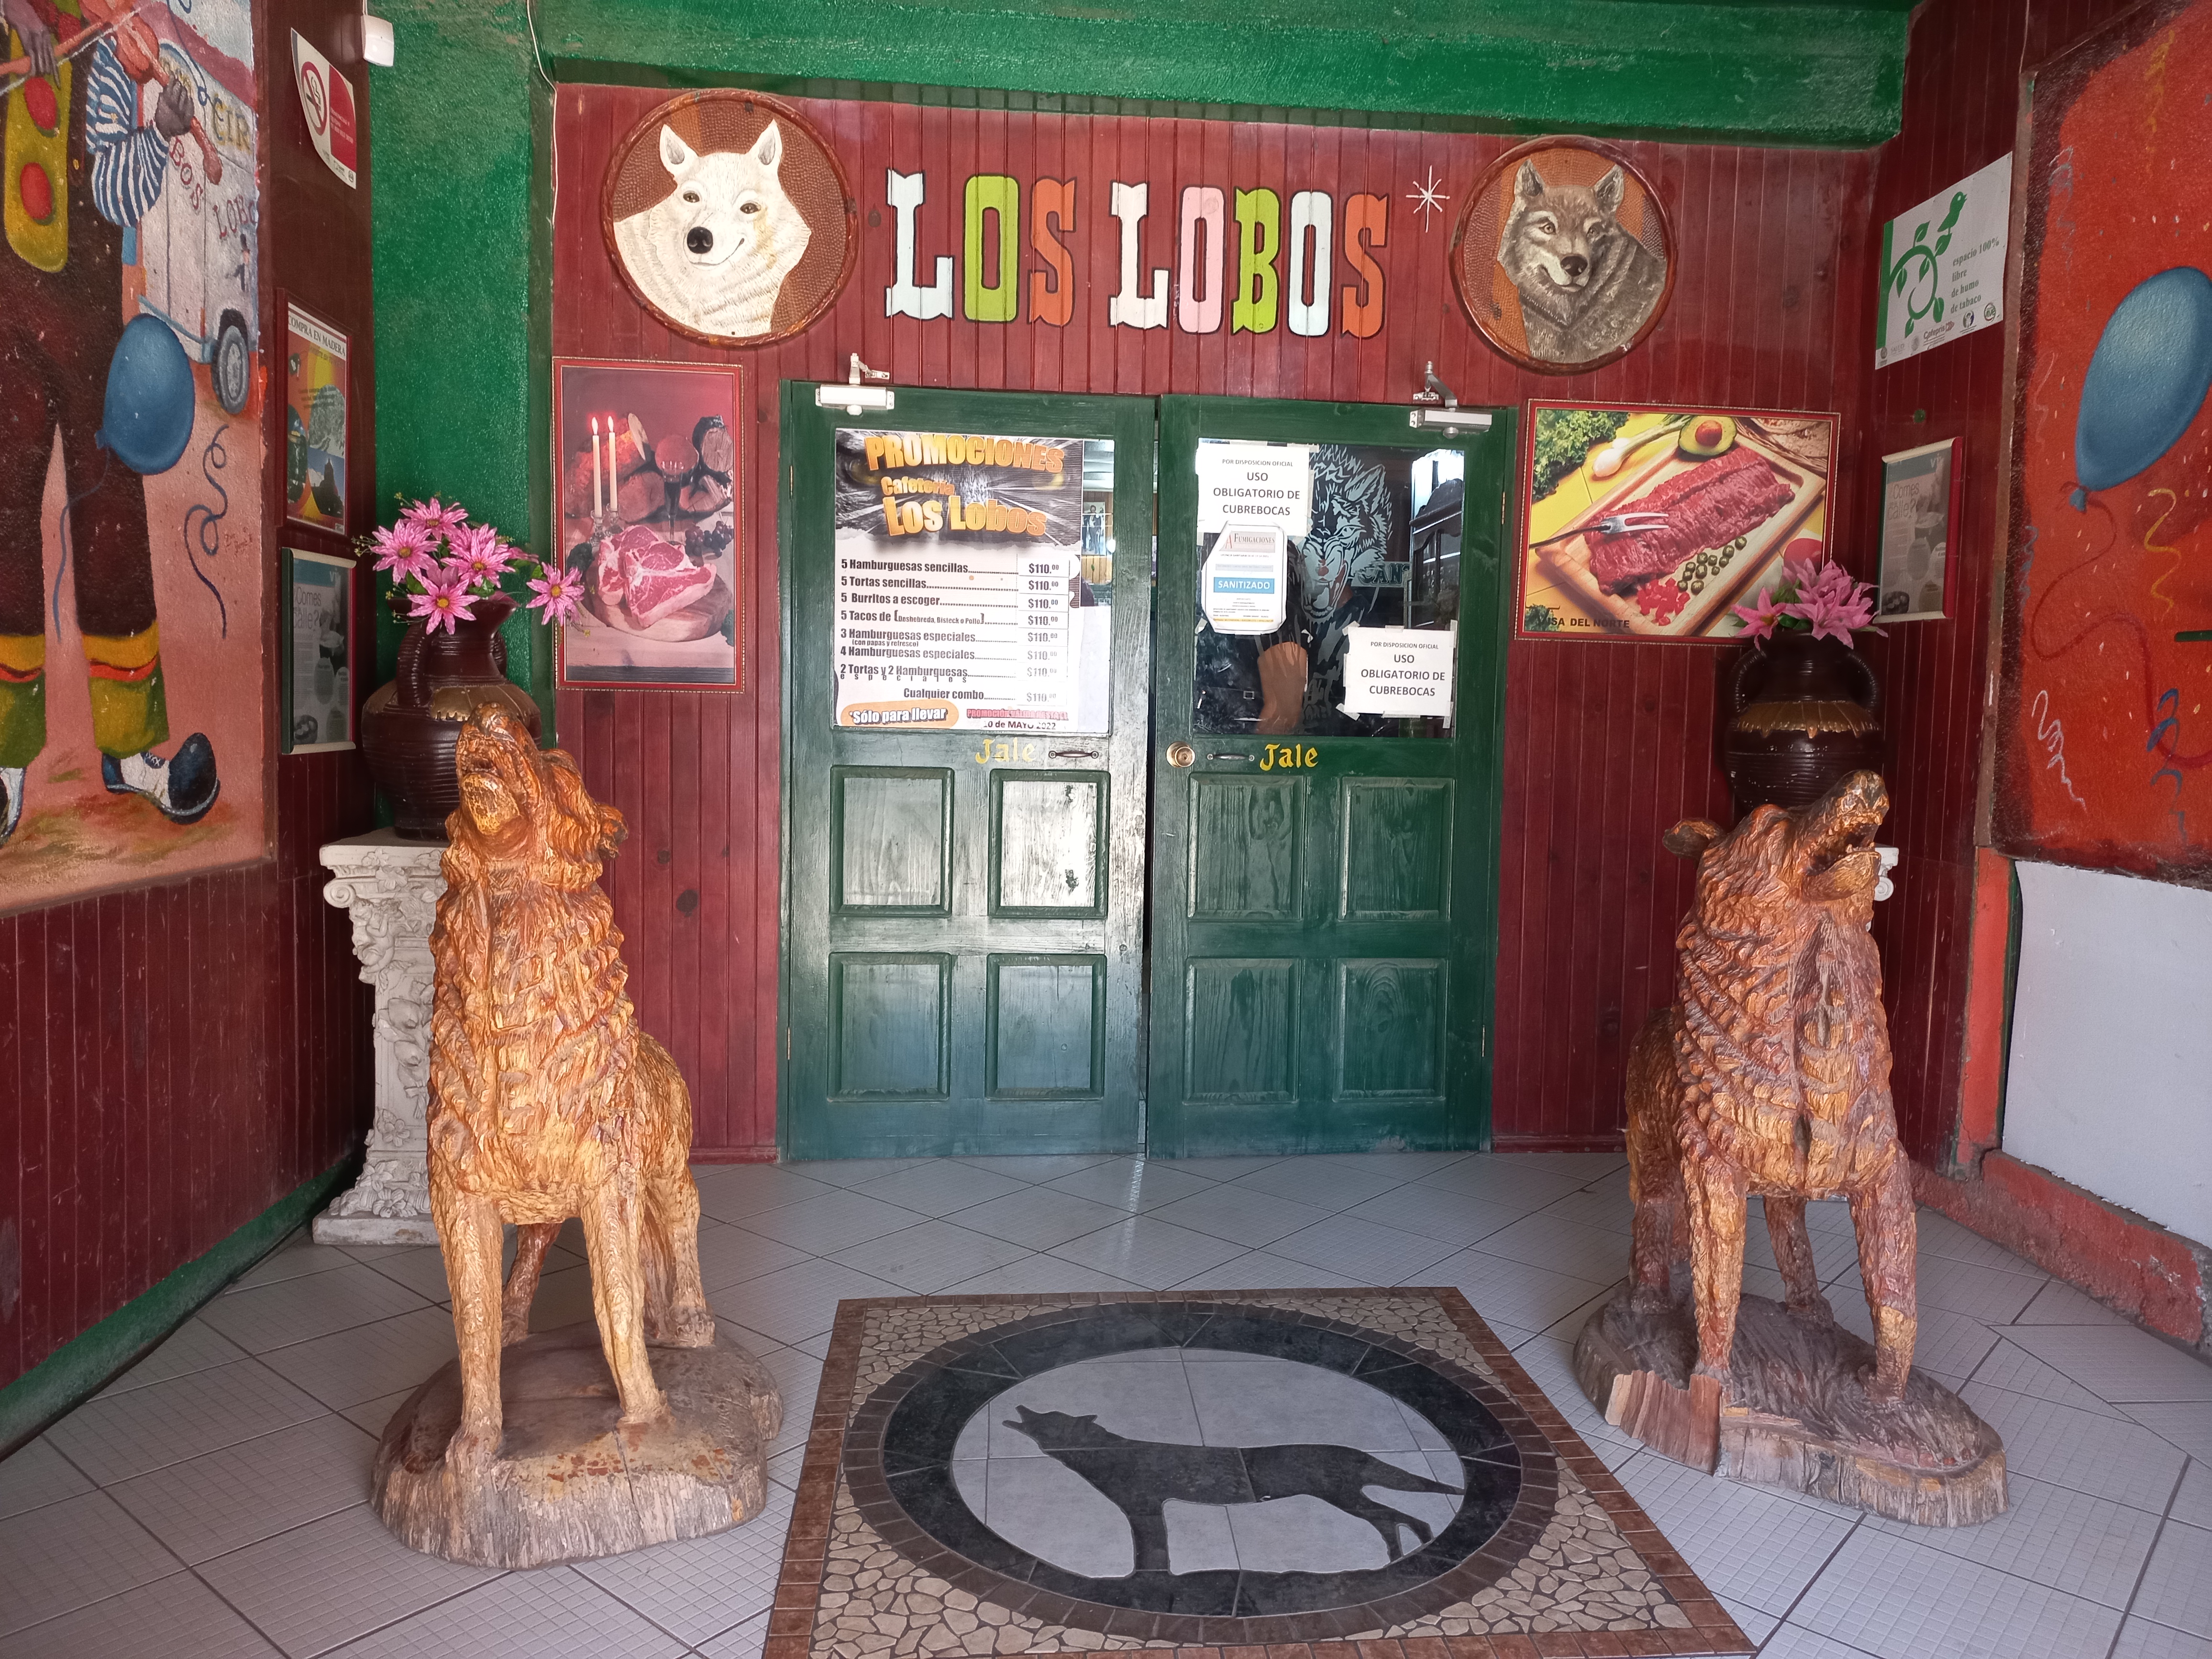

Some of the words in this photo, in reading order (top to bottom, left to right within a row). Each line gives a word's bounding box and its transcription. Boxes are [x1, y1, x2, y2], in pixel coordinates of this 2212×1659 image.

[886, 168, 1077, 327] LOS
[1108, 180, 1388, 339] LOBOS
[1953, 248, 1977, 266] espacio
[1980, 237, 1999, 254] 100%
[1952, 269, 1967, 282] libre
[1951, 288, 1959, 298] de
[1960, 280, 1979, 294] humo
[1950, 304, 1958, 314] de
[1959, 295, 1981, 310] tabaco
[314, 330, 321, 343] EN
[322, 335, 345, 356] MADERA
[864, 434, 1065, 473] PROMOCIONES
[1247, 472, 1268, 481] USO
[1213, 487, 1284, 498] OBLIGATORIO
[1288, 491, 1300, 499] DE
[1223, 505, 1290, 515] CUBREBOCAS
[841, 559, 847, 569] 5
[850, 559, 922, 572] Hamburguesas
[841, 576, 847, 586] 5
[850, 576, 880, 587] Tortas
[1218, 580, 1270, 589] SANITIZADO
[841, 593, 847, 602] 5
[852, 593, 891, 604] Burritos
[841, 610, 847, 620] 5
[849, 611, 877, 621] Tacos
[879, 612, 891, 621] de
[1570, 618, 1590, 627] DEL
[1593, 619, 1630, 629] NORTE
[841, 628, 847, 638] 3
[849, 629, 921, 641] Hamburguesas
[841, 646, 846, 656] 4
[849, 646, 920, 658] Hamburguesas
[1394, 654, 1415, 663] USO
[841, 664, 846, 674] 2
[848, 664, 879, 675] Tortas
[881, 667, 886, 676] y
[888, 665, 894, 675] 2
[896, 665, 968, 677] Hamburguesas
[1361, 669, 1429, 680] OBLIGATORIO
[1433, 672, 1445, 681] DE
[904, 688, 950, 699] Cualquier
[1370, 686, 1435, 697] CUBREBOCAS
[881, 711, 910, 724] para
[912, 708, 948, 720] llevar
[975, 737, 1037, 764] Jale
[1260, 743, 1319, 771] Jale
